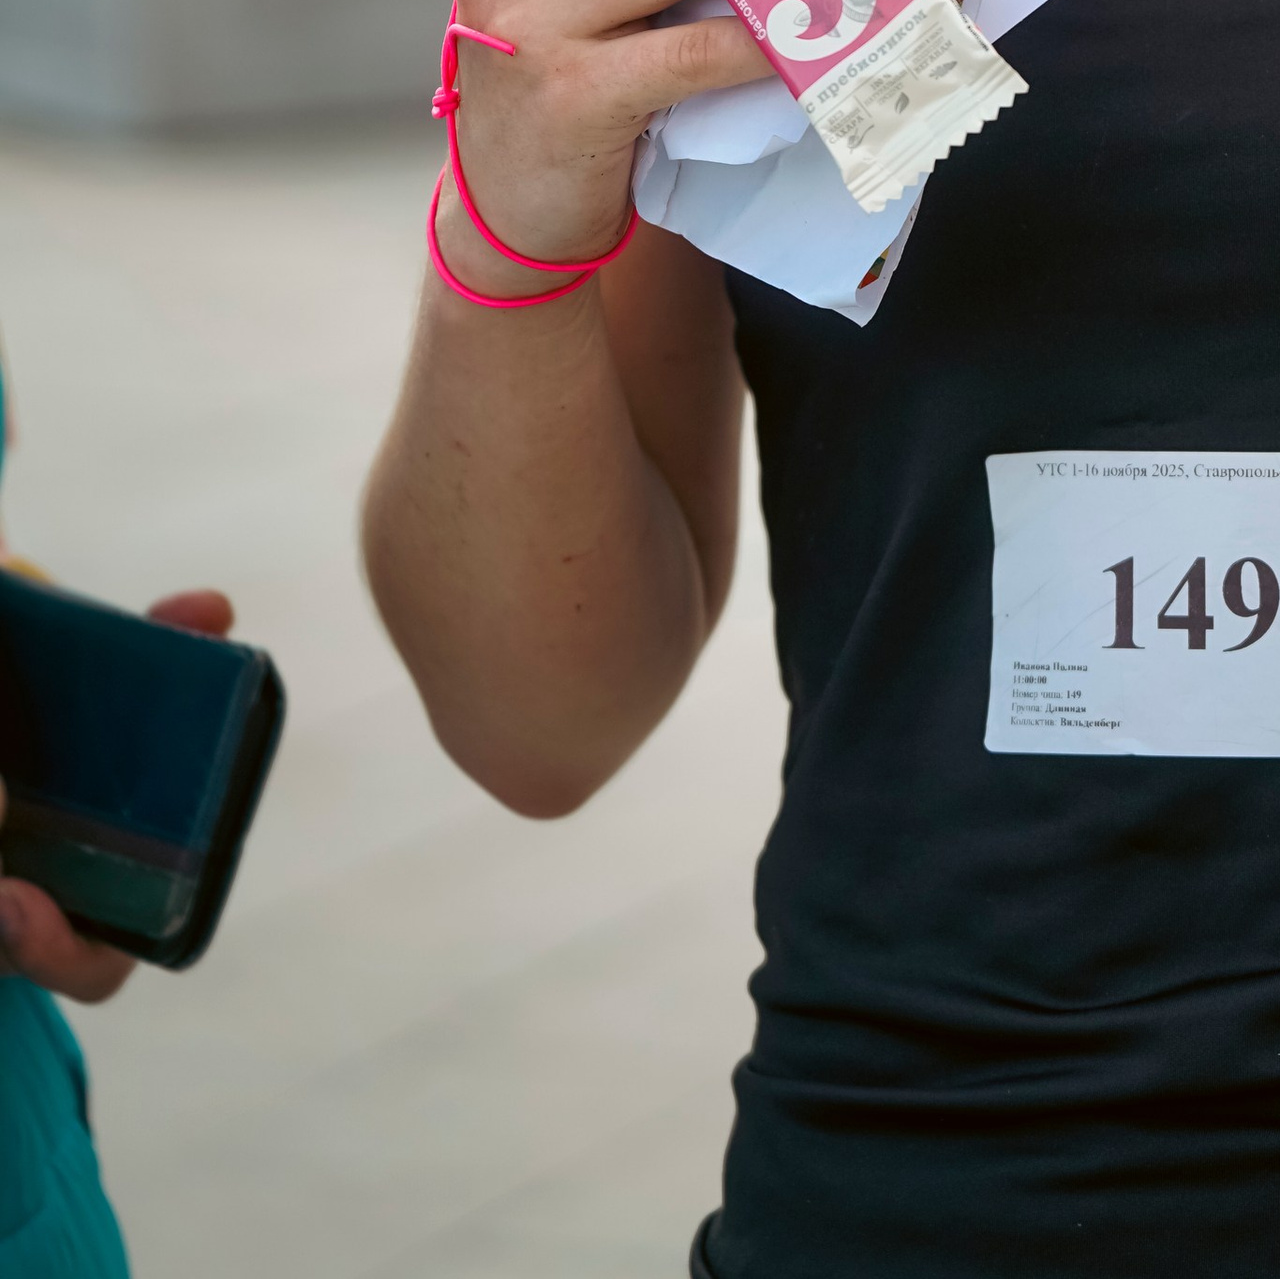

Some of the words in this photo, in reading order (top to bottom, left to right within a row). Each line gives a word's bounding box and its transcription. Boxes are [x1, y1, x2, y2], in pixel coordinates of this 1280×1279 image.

[805, 102, 816, 114] с
[817, 9, 928, 104] пребиотиком
[1037, 462, 1068, 478] УТС
[1072, 462, 1099, 478] 1-16
[1102, 462, 1148, 479] ноября
[1151, 462, 1189, 480] 2025,
[1101, 556, 1280, 653] 149
[1012, 689, 1039, 701] Номер
[1066, 690, 1083, 700] 149
